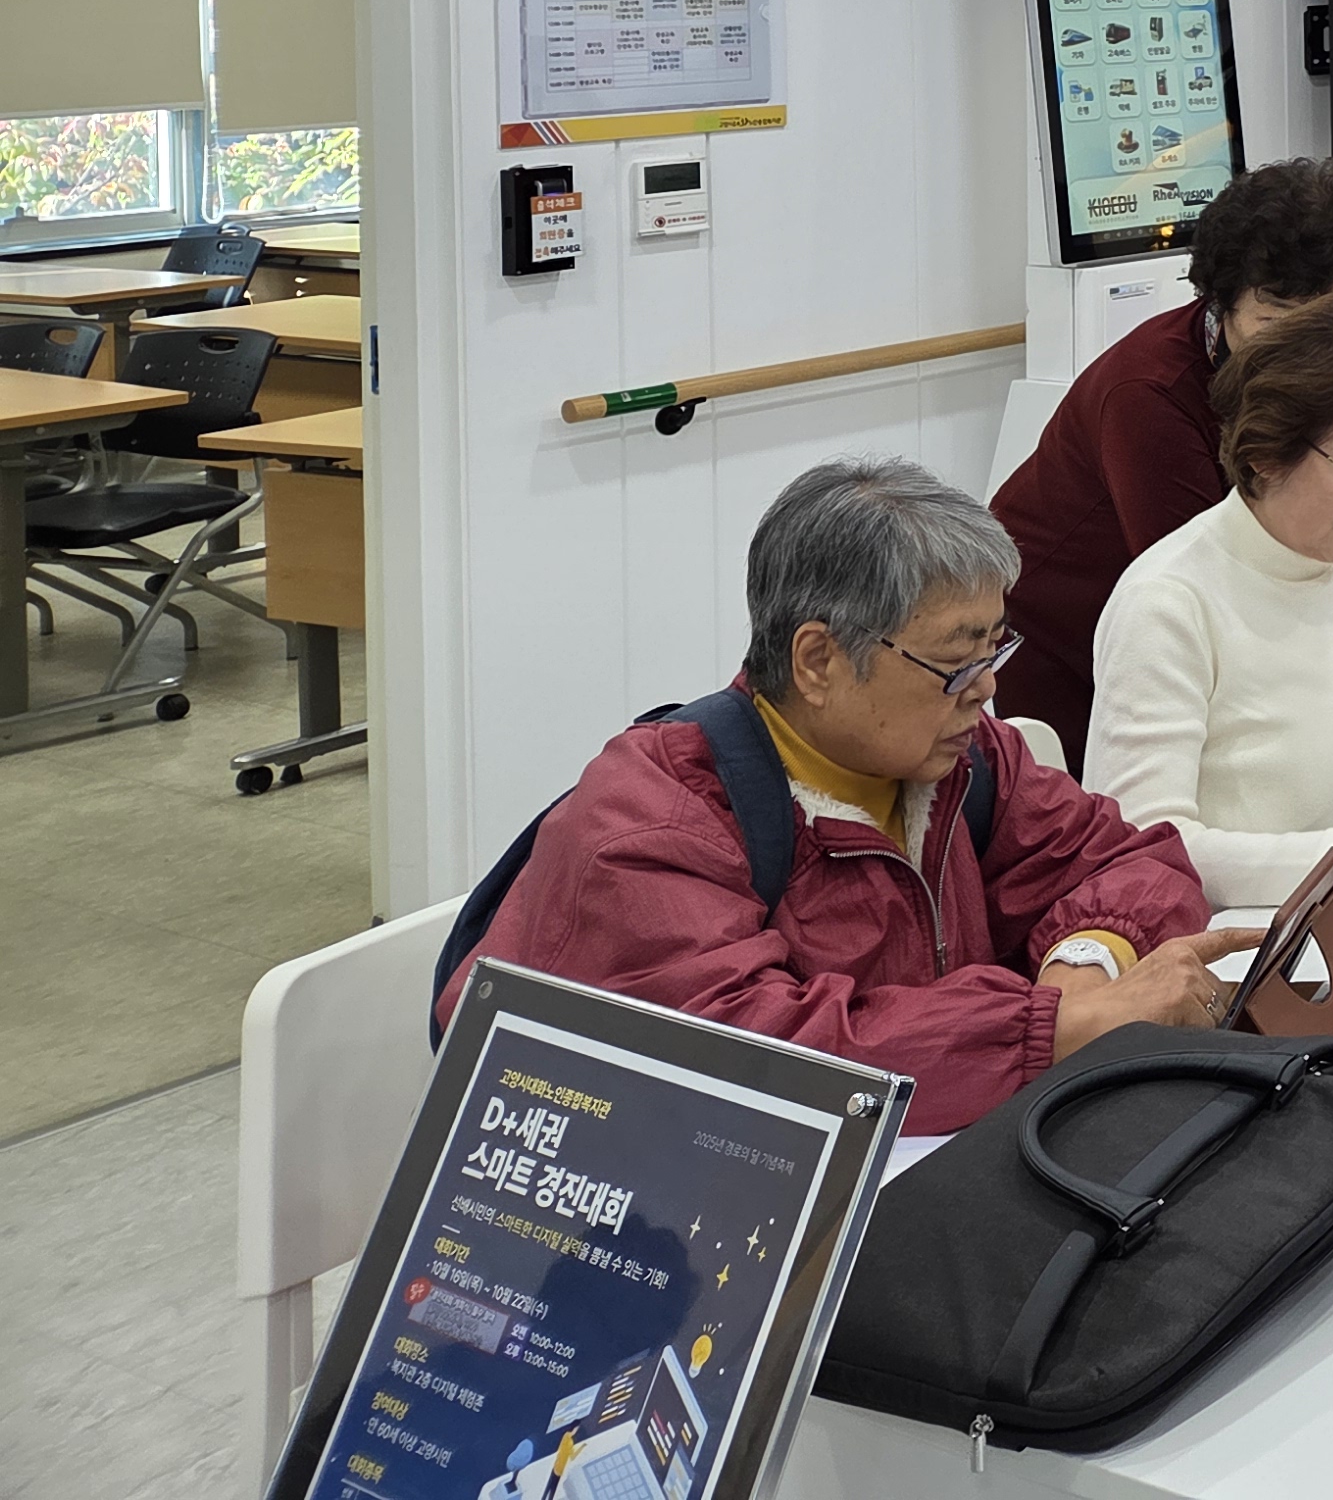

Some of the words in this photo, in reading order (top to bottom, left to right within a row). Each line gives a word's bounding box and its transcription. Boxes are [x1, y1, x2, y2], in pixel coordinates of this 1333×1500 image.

[1087, 194, 1138, 218] KIOEDU
[1179, 211, 1201, 221] 1544-
[499, 1068, 613, 1120] 고양시대화노인종합복지관
[480, 1096, 570, 1159] D+세권
[693, 1130, 726, 1153] 2025년
[724, 1140, 751, 1162] 경로의
[749, 1148, 761, 1165] 달
[760, 1152, 795, 1176] 기념축제
[461, 1141, 537, 1197] 스마트
[535, 1164, 634, 1236] 경진대회
[433, 1236, 471, 1264] 대회기간
[451, 1194, 495, 1225] 선배시민의
[494, 1213, 533, 1239] 스마트한
[532, 1225, 564, 1251] 디지털
[560, 1235, 592, 1263] 실력을
[588, 1246, 614, 1270] 뽐낼
[610, 1256, 623, 1274] 수
[620, 1259, 646, 1282] 있는
[643, 1267, 670, 1291] 기회!
[430, 1259, 452, 1281] 10월
[450, 1267, 485, 1294] 16일(목)
[491, 1284, 513, 1306] 10월
[511, 1292, 549, 1321] 22일(수)
[393, 1336, 430, 1363] 대회장소
[522, 1350, 569, 1378] 13:00~15:00
[530, 1331, 576, 1359] 10:00~12:00
[389, 1358, 418, 1383] 복지관
[414, 1369, 433, 1390] 2층
[431, 1376, 459, 1402] 디지털
[456, 1387, 485, 1413] 체험존
[371, 1391, 410, 1421] 참여대상
[376, 1421, 401, 1444] 60세
[398, 1431, 419, 1452] 이상
[414, 1439, 453, 1469] 고양시민
[346, 1454, 387, 1485] 대회종목
